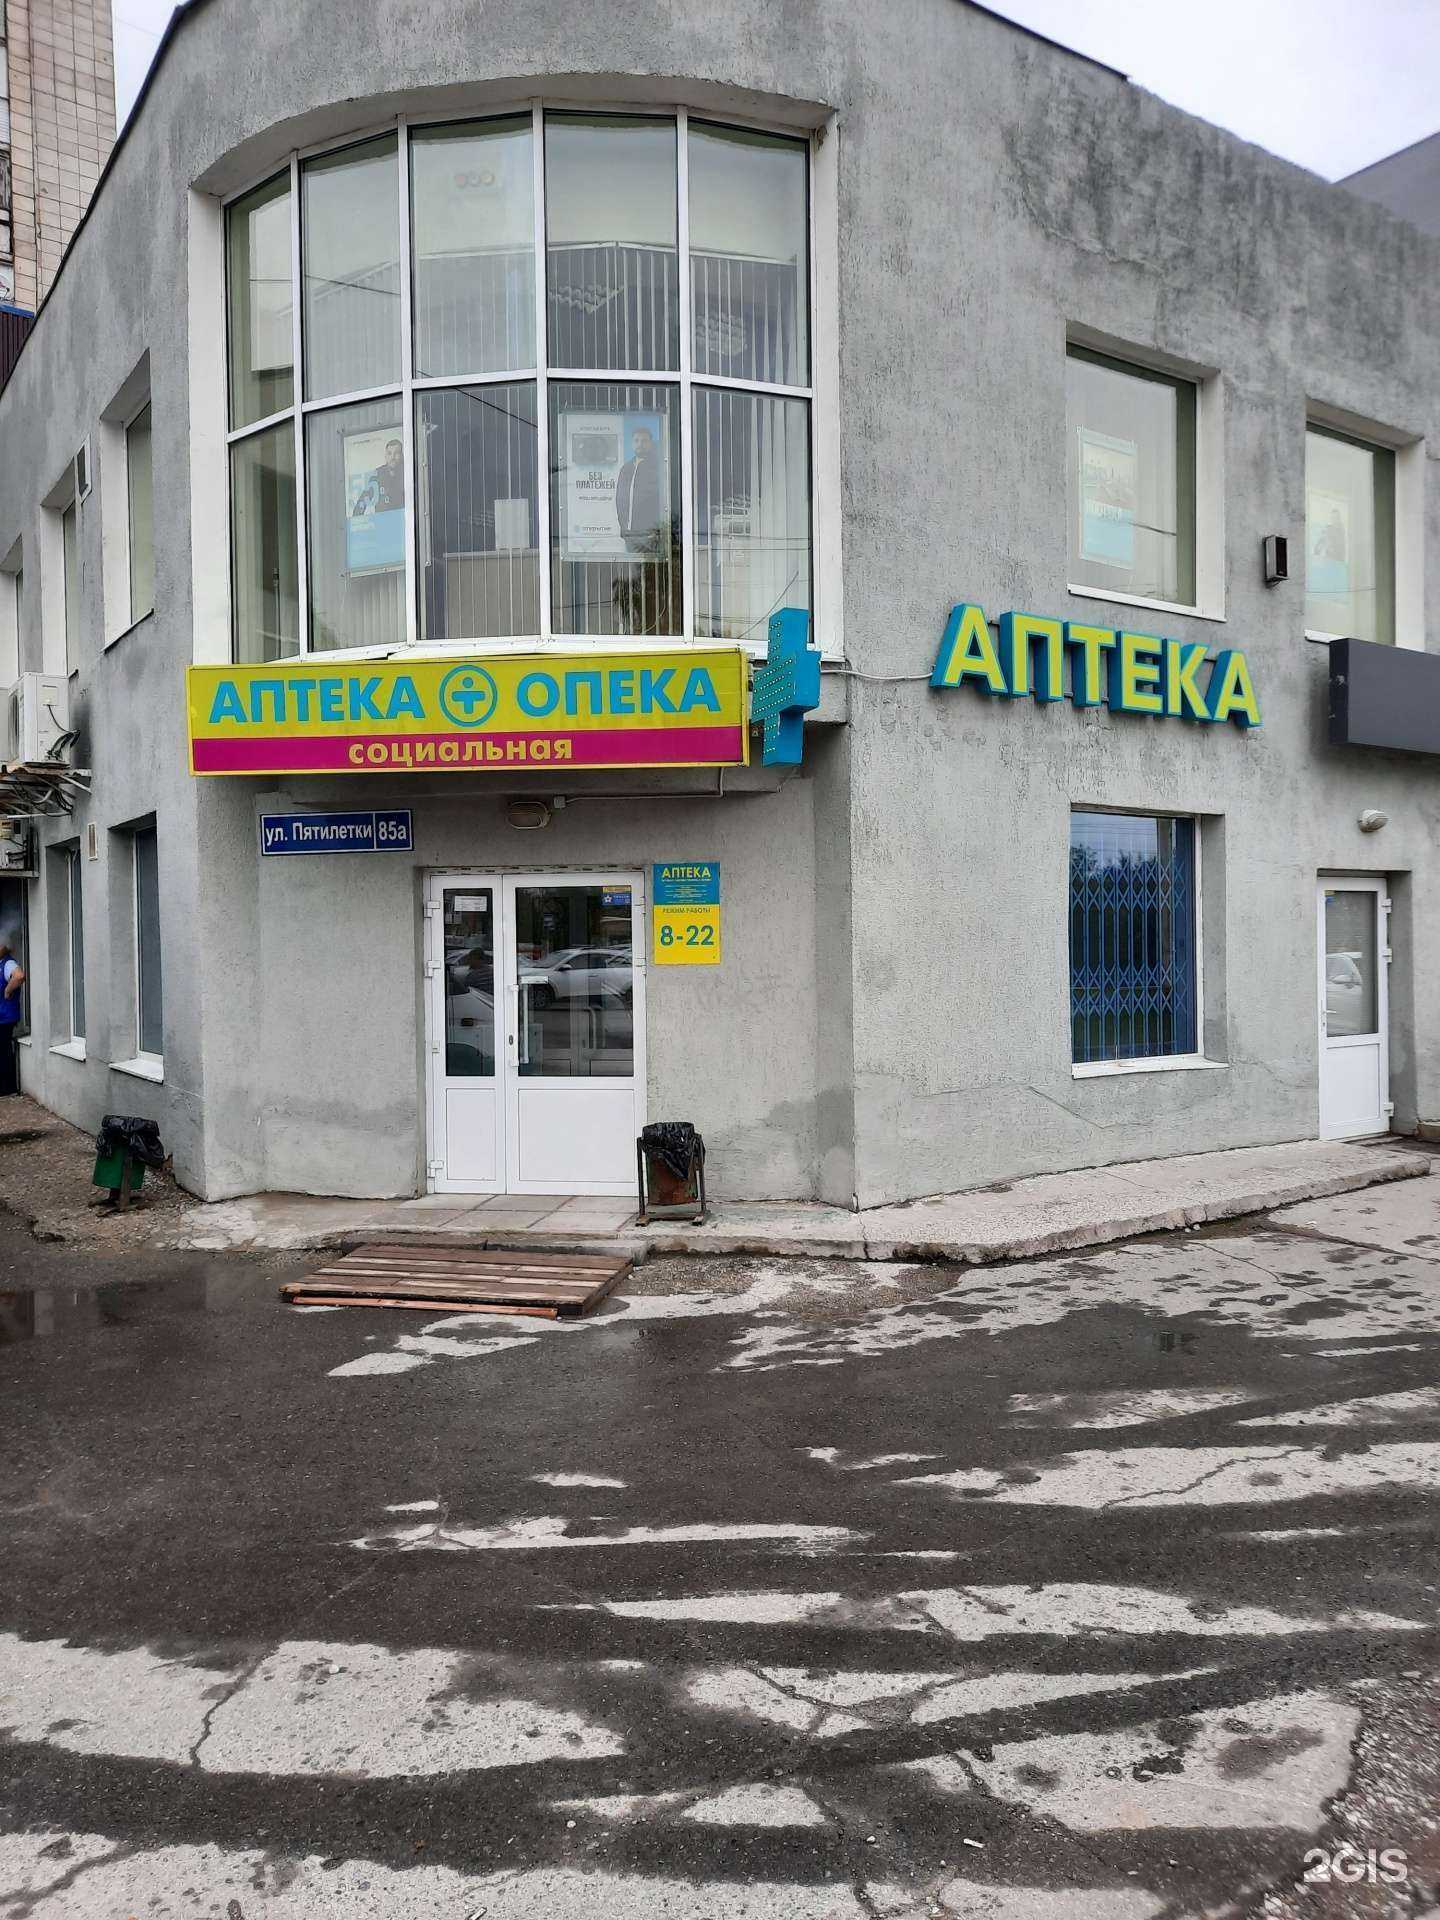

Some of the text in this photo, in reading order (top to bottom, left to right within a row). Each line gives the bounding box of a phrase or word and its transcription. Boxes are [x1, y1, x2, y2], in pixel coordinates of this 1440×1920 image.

[576, 480, 616, 490] ПЛАТЕЖЕЙ
[929, 602, 1264, 728] АПТЕКА
[207, 667, 722, 724] АПТЕКА ОПЕКА
[347, 738, 573, 768] социальная
[265, 820, 407, 847] ул. Пятилетки 85а
[661, 866, 711, 879] АПТЕКА
